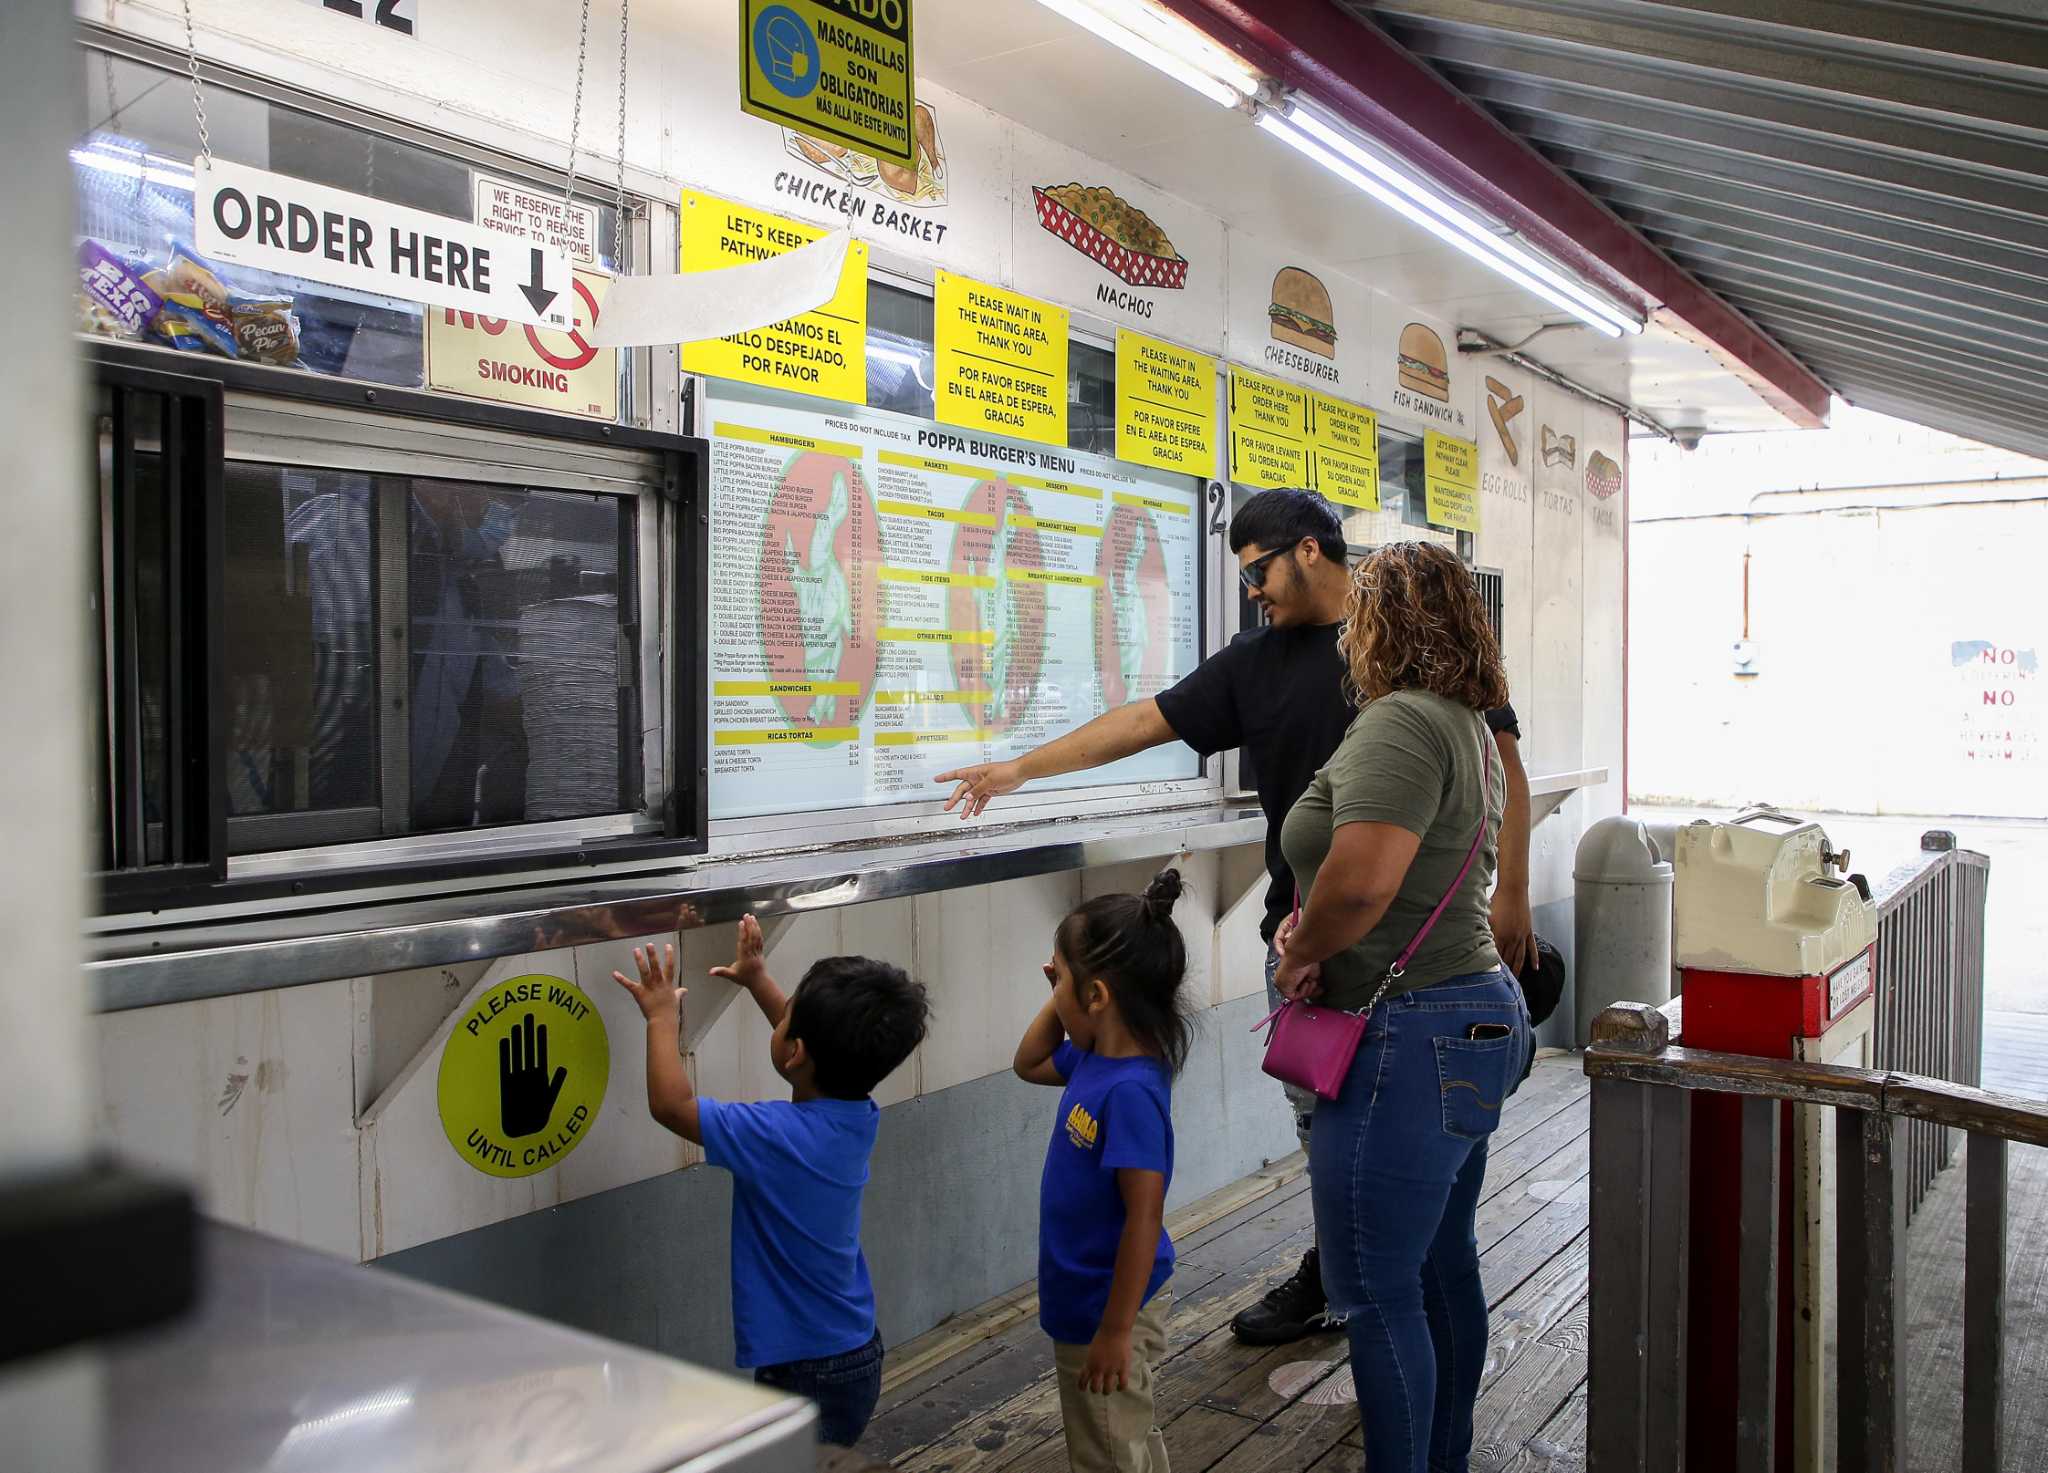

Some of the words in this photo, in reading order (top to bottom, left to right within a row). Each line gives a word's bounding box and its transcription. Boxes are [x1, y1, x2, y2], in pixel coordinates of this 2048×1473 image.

[817, 19, 904, 74] MASCARILLAS
[847, 60, 878, 85] SON
[819, 71, 903, 120] OBLIGATORIAS
[816, 95, 832, 115] MÁS
[853, 110, 863, 126] DE
[865, 114, 881, 133] ESTE
[883, 124, 906, 142] PUNTO
[494, 189, 509, 204] WE
[515, 195, 560, 218] RESERVE
[774, 171, 866, 218] CHICKEN
[872, 204, 947, 245] BASKET
[492, 205, 523, 223] RIGHT
[529, 214, 541, 228] TO
[213, 187, 375, 269] ORDER
[390, 227, 491, 294] HERE
[483, 218, 526, 237] SERVICE
[531, 231, 545, 243] TO
[727, 215, 763, 239] LET'S
[768, 227, 802, 249] KEEP
[95, 260, 151, 313] BIG
[968, 292, 1003, 313] PLEASE
[1006, 303, 1029, 320] WAIT
[1032, 311, 1041, 324] IN
[1096, 283, 1154, 319] NACHOS
[240, 322, 284, 339] Pecan
[769, 320, 823, 341] GAMOS
[828, 330, 842, 345] EL
[959, 308, 977, 323] THE
[980, 314, 1020, 336] WAITING
[1024, 327, 1049, 345] AREA,
[253, 335, 279, 353] Pie
[720, 331, 761, 349] SILLO
[766, 338, 846, 369] DESPEJADO,
[977, 331, 1010, 350] THANK
[1013, 341, 1032, 356] YOU
[743, 354, 771, 373] POR
[775, 361, 819, 383] FAVOR
[1134, 360, 1148, 374] THE
[1149, 365, 1180, 382] WAITING
[1141, 346, 1168, 364] PLEASE
[1169, 354, 1187, 369] WAIT
[1188, 361, 1196, 372] IN
[1264, 345, 1340, 384] CHEESEBURGER
[478, 359, 568, 393] SMOKING
[959, 366, 979, 381] POR
[982, 372, 1013, 389] FAVOR
[1015, 380, 1048, 398] ESPERE
[948, 382, 962, 396] EN
[966, 386, 976, 399] EL
[979, 390, 1004, 405] AREA
[1007, 396, 1018, 409] DE
[1022, 399, 1056, 418] ESPERA,
[1147, 380, 1173, 397] THANK
[1175, 387, 1190, 400] YOU
[1238, 376, 1261, 392] PLEASE
[1261, 384, 1275, 396] PICK
[1276, 387, 1284, 398] UP
[1285, 390, 1301, 404] YOUR
[1252, 395, 1273, 410] ORDER
[985, 409, 1025, 427] GRACIAS
[1255, 409, 1275, 425] THANK
[1276, 416, 1289, 428] YOU
[1318, 400, 1336, 415] PLEASE
[1337, 406, 1349, 418] PICK
[1350, 410, 1357, 420] UP
[1357, 413, 1370, 425] YOUR
[1393, 391, 1411, 408] FISH
[1413, 398, 1453, 422] SANDWICH
[825, 418, 848, 430] PRICES
[850, 424, 858, 432] DO
[860, 425, 872, 434] NOT
[873, 427, 899, 440] INCLUDE
[900, 433, 912, 442] TAX
[1126, 424, 1137, 436] EN
[1139, 427, 1147, 439] EL
[1149, 431, 1167, 444] AREA
[1170, 436, 1179, 446] DE
[1134, 410, 1150, 424] POR
[1151, 415, 1175, 430] FAVOR
[1176, 421, 1201, 436] ESPERE
[1330, 418, 1346, 431] ORDER
[770, 434, 815, 448] HAMBURGERS
[918, 429, 966, 454] POPPA
[970, 439, 1037, 467] BURGER'S
[1040, 454, 1075, 474] MENU
[1241, 437, 1254, 449] POR
[1255, 440, 1275, 455] FAVOR
[1276, 446, 1301, 460] LEVANTE
[1331, 431, 1349, 444] THANK
[1350, 437, 1360, 448] YOU
[924, 461, 948, 470] BASKETS
[1153, 446, 1183, 462] GRACIAS
[1248, 452, 1257, 463] SU
[1258, 455, 1279, 470] ORDEN
[1320, 456, 1332, 467] POR
[1332, 459, 1349, 471] FAVOR
[1350, 464, 1370, 476] LEVANTE
[1260, 470, 1286, 484] GRACIAS
[1327, 472, 1334, 481] SU
[1335, 473, 1353, 485] ORDEN
[1482, 472, 1502, 495] EGG
[1503, 480, 1528, 504] ROLLS
[1338, 486, 1359, 499] GRACIAS
[1543, 490, 1573, 515] TORTAS
[1209, 482, 1226, 535] 2
[1983, 648, 2015, 665] NO
[1983, 690, 2015, 706] NO
[767, 732, 787, 740] RICAS
[789, 731, 813, 739] TORTAS
[466, 983, 542, 1036] PLEASE
[549, 985, 590, 1021] WAIT
[467, 1128, 516, 1168] UNTIL
[523, 1104, 588, 1166] CALLED
